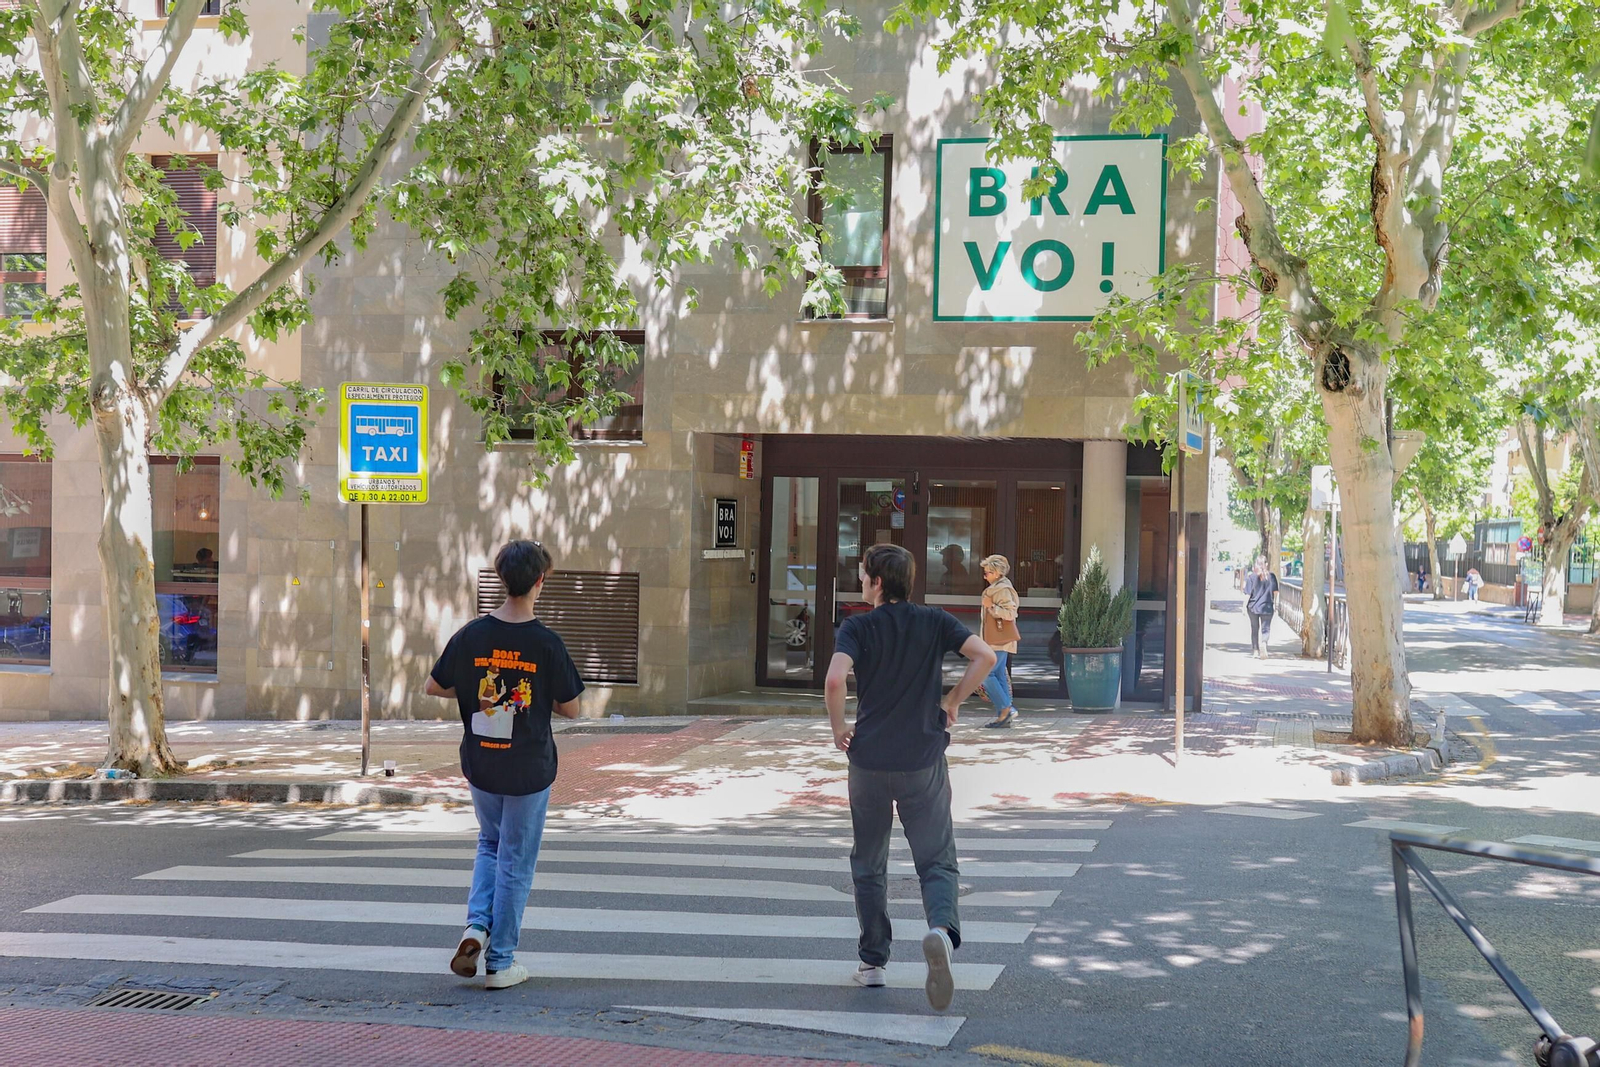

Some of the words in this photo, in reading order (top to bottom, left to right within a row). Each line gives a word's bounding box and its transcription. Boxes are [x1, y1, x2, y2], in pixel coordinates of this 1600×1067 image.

[968, 164, 1136, 217] BRA
[963, 239, 1115, 293] VO!
[361, 446, 408, 462] TAXI
[348, 493, 359, 501] DE
[719, 508, 735, 521] BRA
[718, 526, 733, 539] VO!
[493, 649, 521, 660] BOAT
